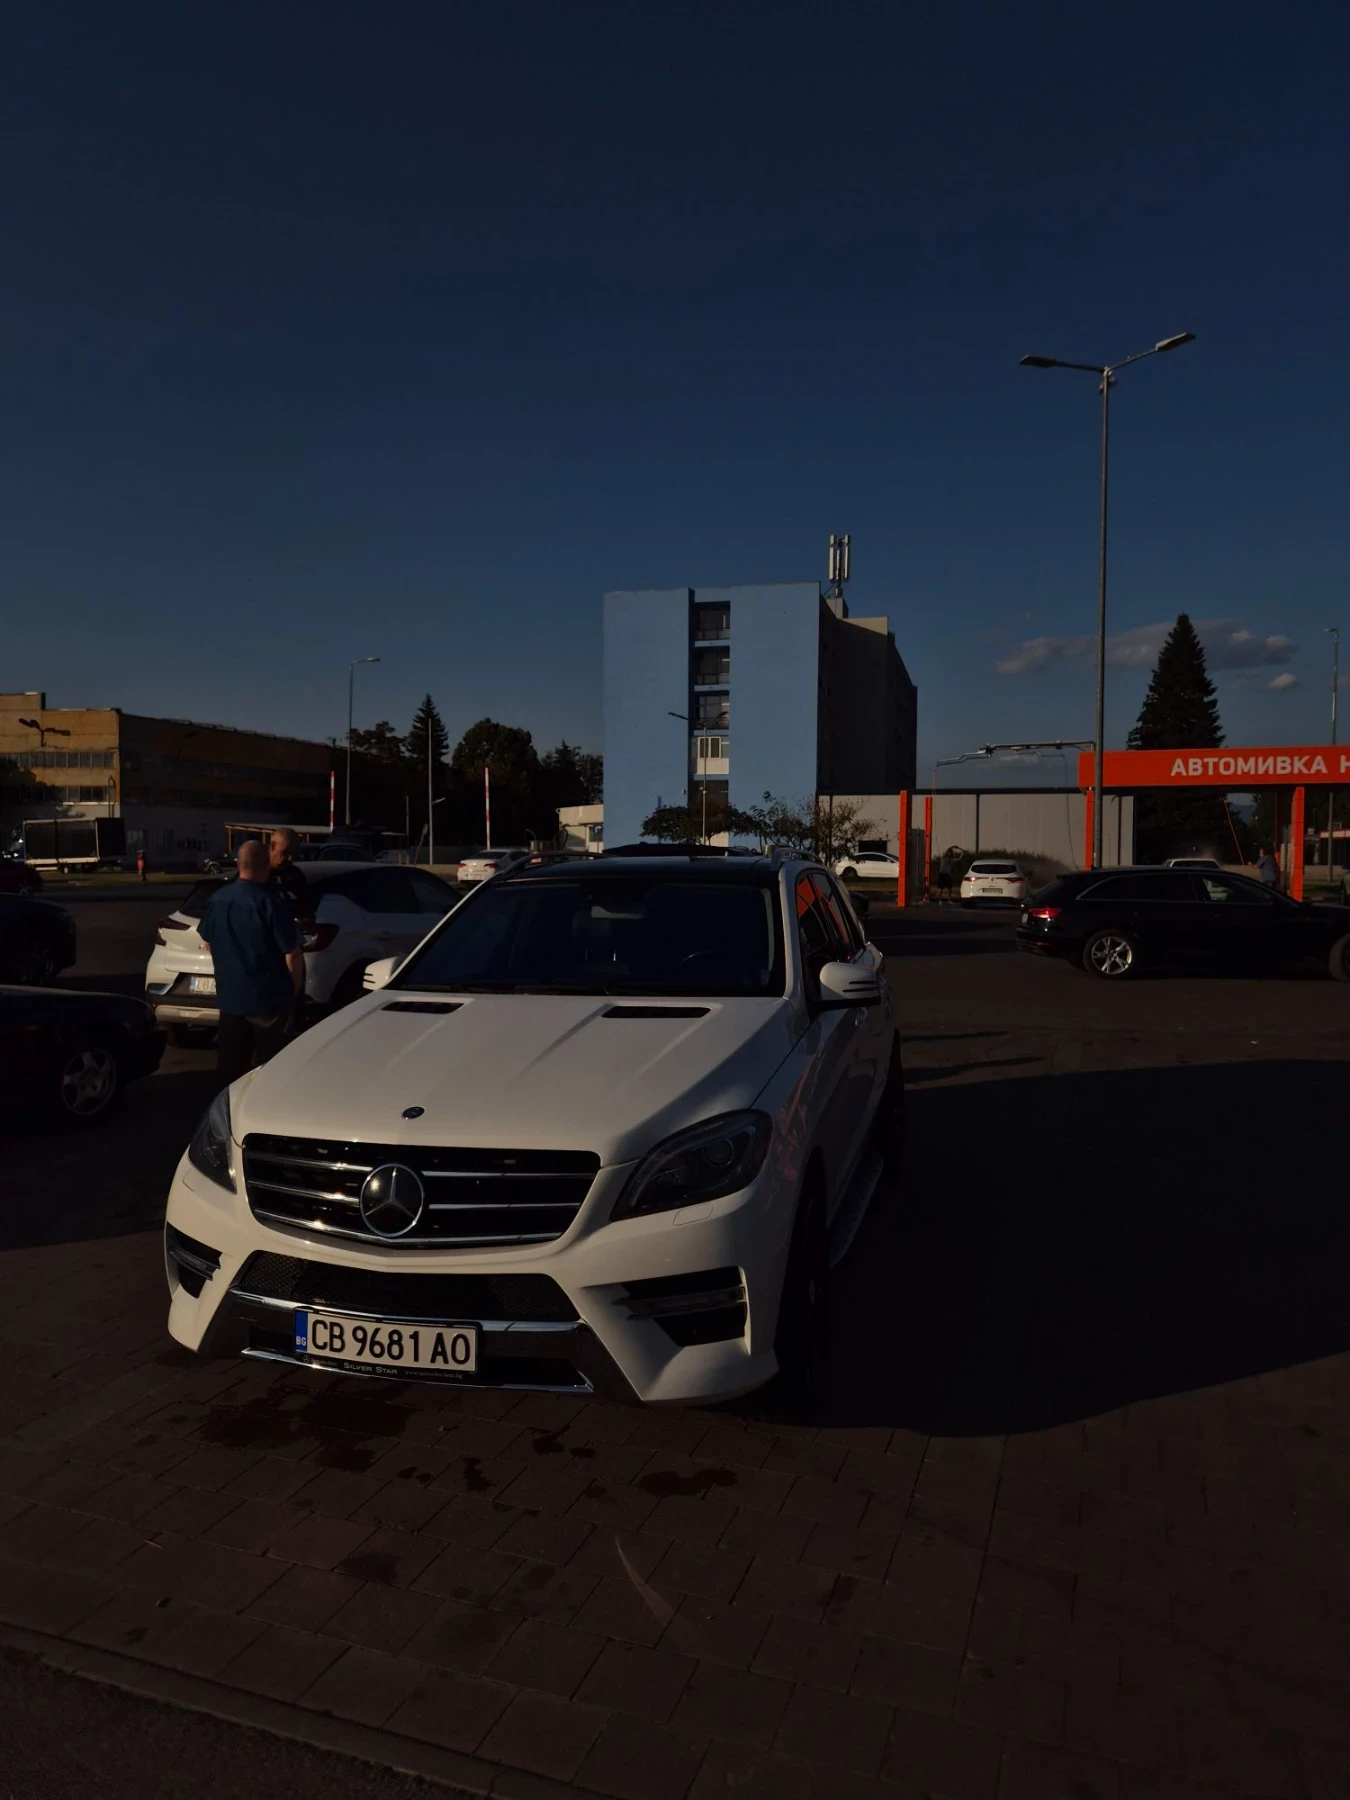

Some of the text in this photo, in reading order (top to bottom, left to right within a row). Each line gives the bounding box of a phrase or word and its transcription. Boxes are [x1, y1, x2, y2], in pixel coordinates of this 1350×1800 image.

[1170, 755, 1328, 777] АВТОМИВКА
[295, 1335, 307, 1346] BG
[311, 1319, 471, 1365] CB 9681 AO
[343, 1362, 373, 1373] SILVER
[375, 1365, 398, 1375] STAR
